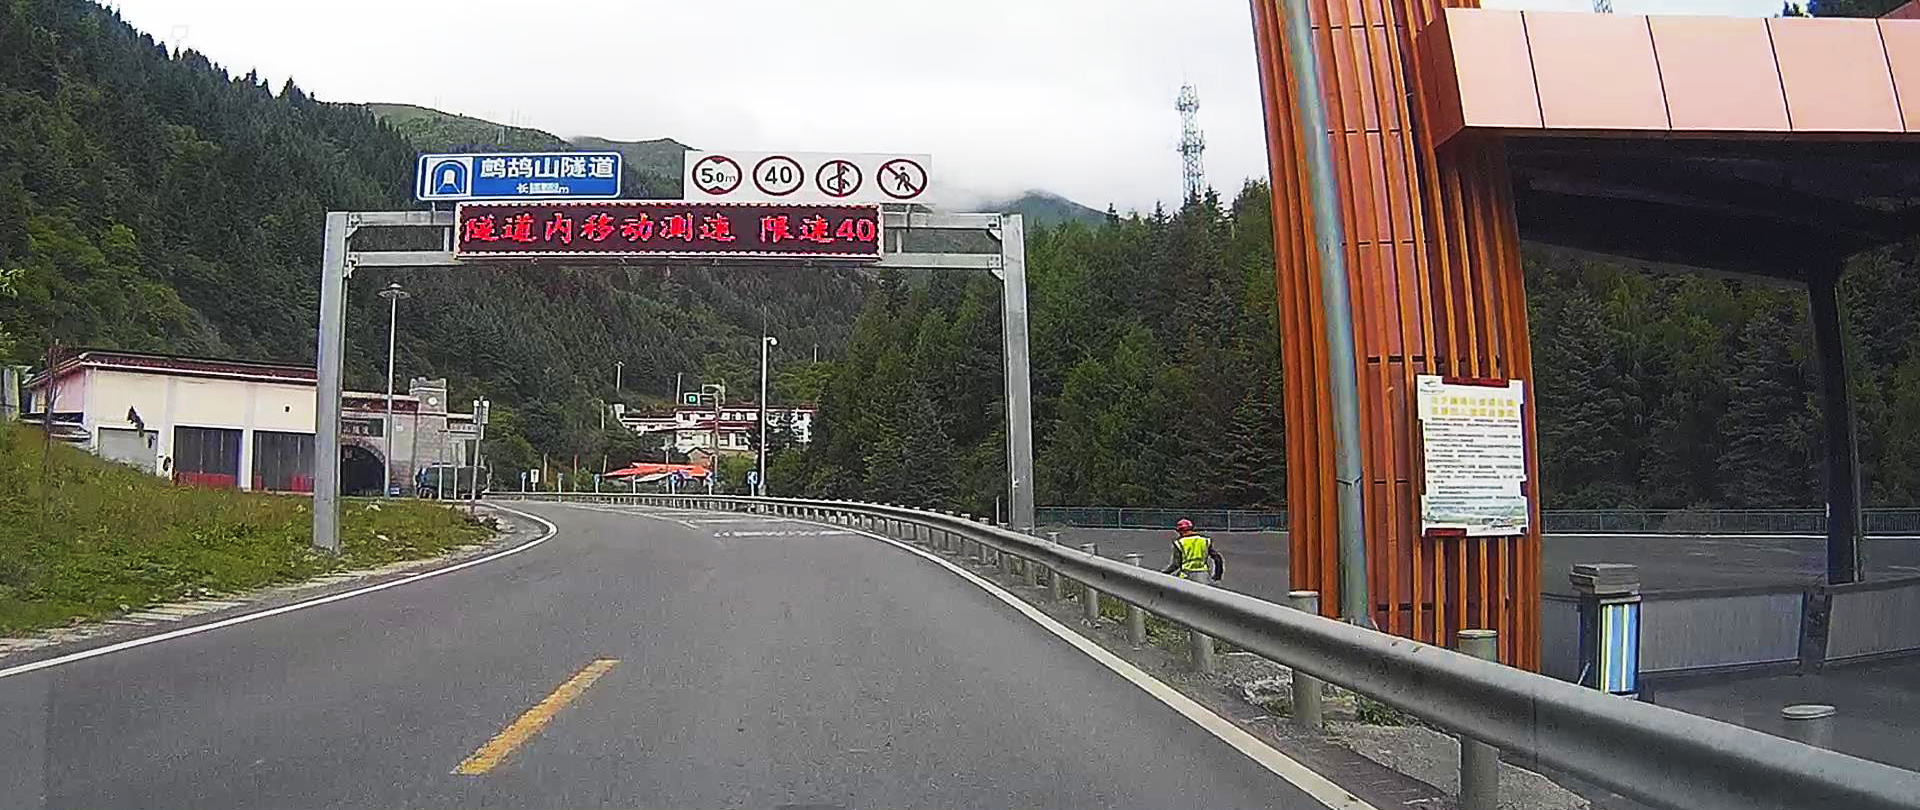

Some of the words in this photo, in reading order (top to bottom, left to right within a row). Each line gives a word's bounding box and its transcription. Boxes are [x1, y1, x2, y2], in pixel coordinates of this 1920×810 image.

[480, 156, 615, 179] 鹧鸪山隧道
[701, 167, 736, 184] 5.0m
[764, 166, 793, 184] 40
[463, 212, 737, 244] 隧道内移动测速
[758, 214, 876, 244] 限速40
